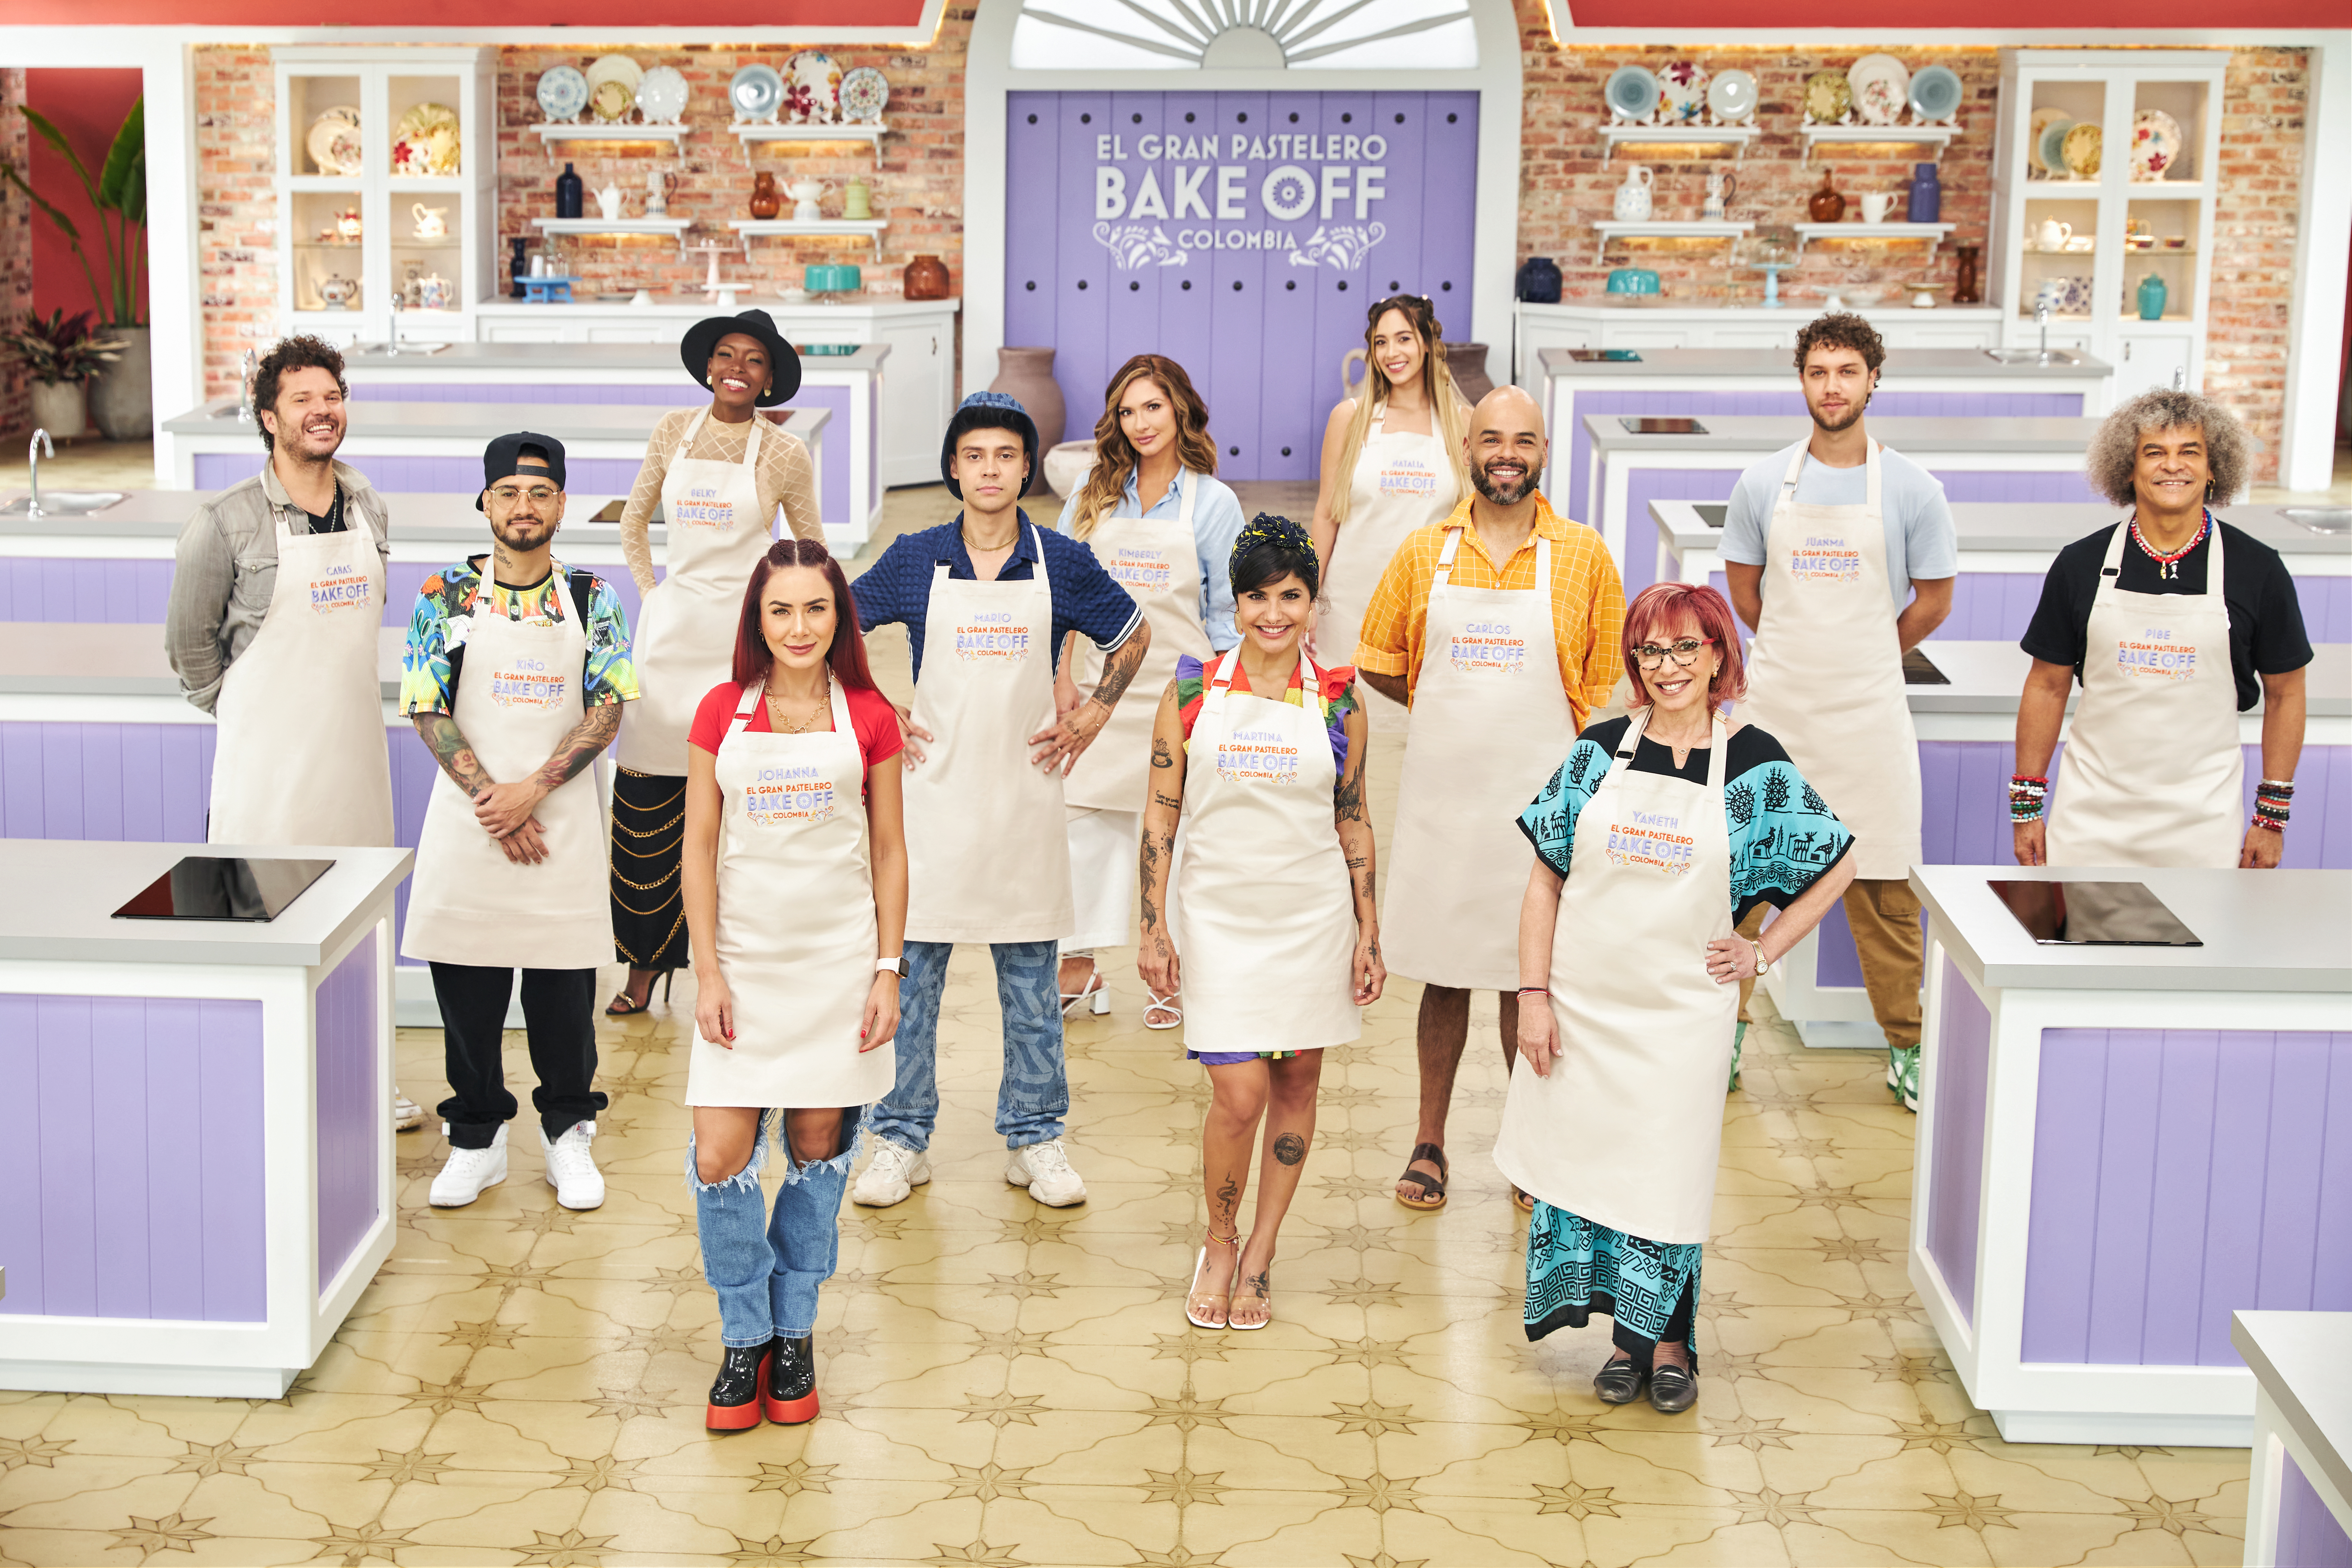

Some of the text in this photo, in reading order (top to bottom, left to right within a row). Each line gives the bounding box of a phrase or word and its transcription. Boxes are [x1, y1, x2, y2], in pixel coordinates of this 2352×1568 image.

[1097, 134, 1387, 161] EL GRAN PASTELERO
[1096, 165, 1386, 221] BAKE OFF
[1177, 229, 1297, 250] COLOMBIA
[691, 489, 716, 497] BELKY
[677, 507, 732, 520] BAKE OFF
[1805, 537, 1844, 546] JUANMA
[1119, 548, 1162, 559] KIMBERLY
[326, 565, 352, 576] CABAS
[1793, 557, 1859, 571] BAKE OFF
[339, 576, 367, 585] PASTELERO
[1111, 567, 1170, 582] BAKE OFF
[312, 584, 368, 603] BAKE OFF
[974, 613, 1011, 622] MARIO
[1466, 623, 1510, 634] CARLOS
[2146, 629, 2170, 639] PIBE
[957, 635, 1028, 649] BAKE OFF
[2154, 645, 2195, 653] PASTELERO
[1452, 645, 1524, 661] BAKE OFF
[2119, 649, 2196, 668] BAKE OFF
[517, 659, 544, 671] KIÑO
[494, 680, 564, 697] BAKE OFF
[1233, 731, 1282, 742] MARTINA
[1255, 746, 1297, 755] PASTELERO
[1218, 752, 1298, 771] BAKE OFF
[758, 767, 818, 781] JOHANNA
[759, 785, 783, 794] GRAN
[786, 782, 832, 792] PASTELERO
[747, 791, 833, 811] BAKE OFF
[1633, 810, 1678, 829] YANETH
[1611, 824, 1693, 845] EL GRAN PASTELERO
[1608, 833, 1693, 861] BAKE OFF
[1630, 856, 1664, 867] COLOMBIA
